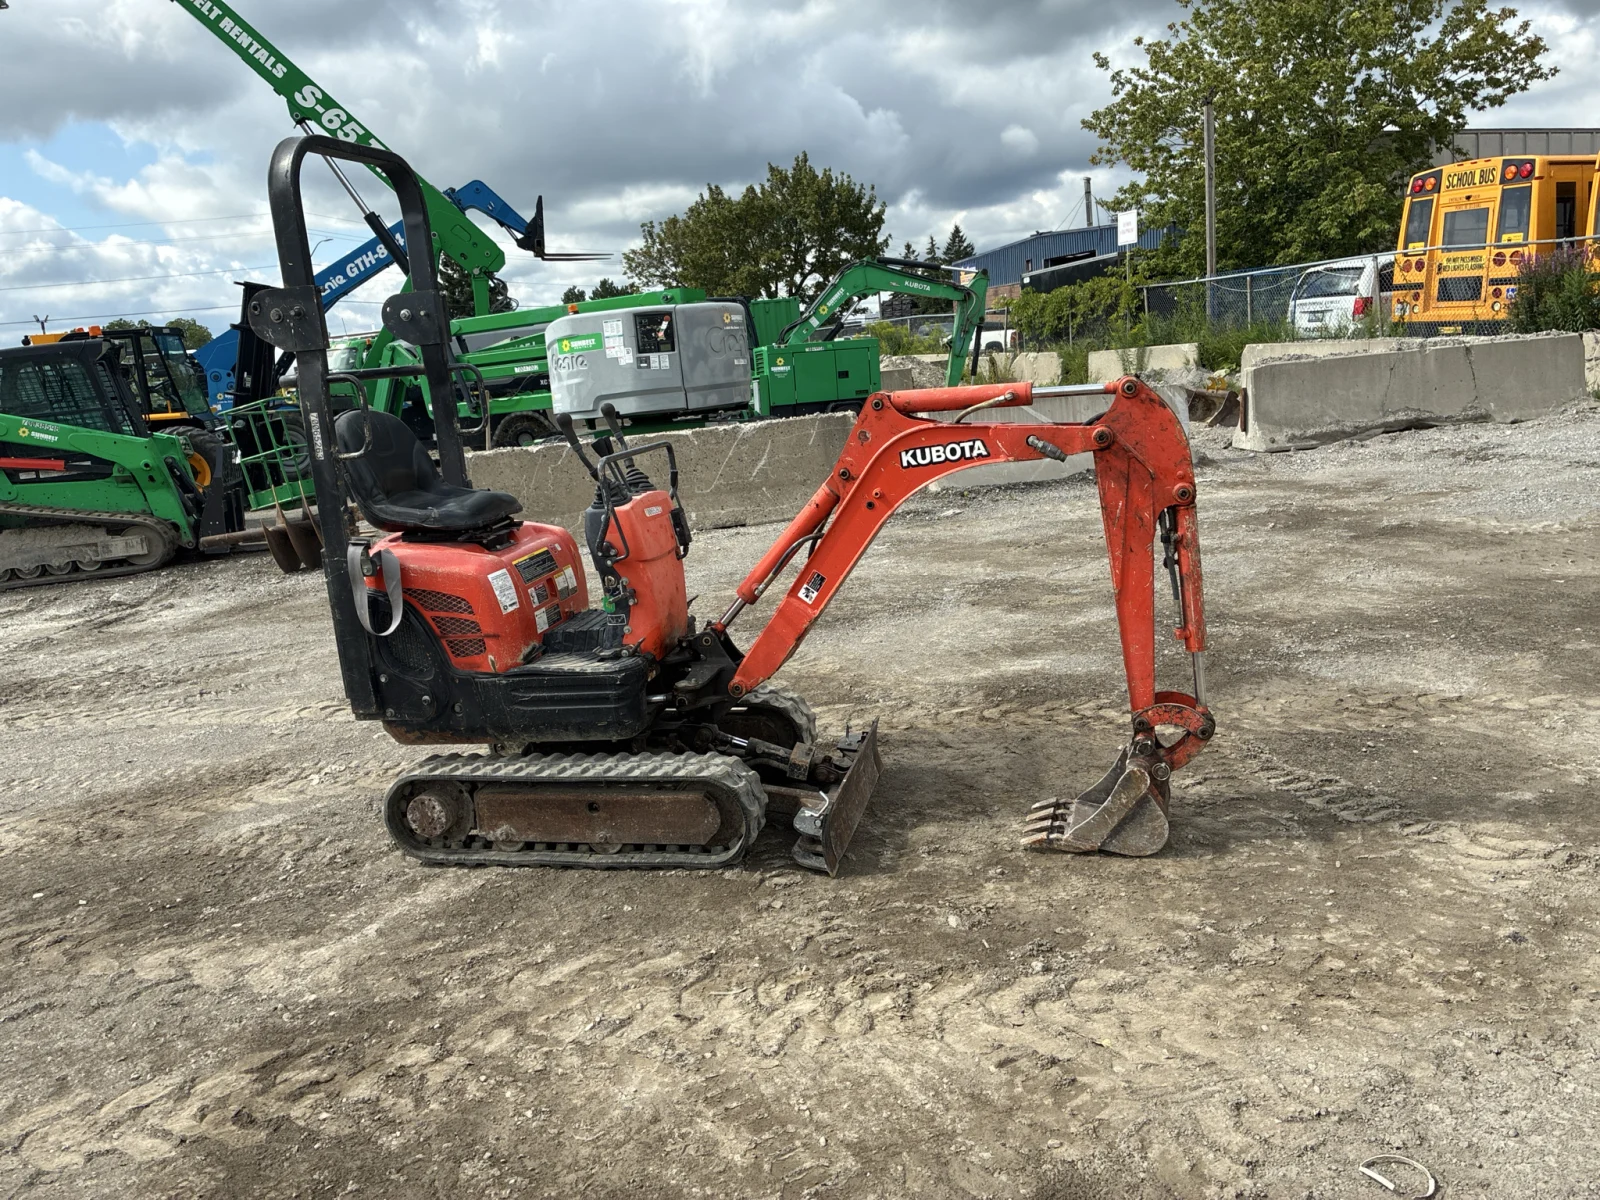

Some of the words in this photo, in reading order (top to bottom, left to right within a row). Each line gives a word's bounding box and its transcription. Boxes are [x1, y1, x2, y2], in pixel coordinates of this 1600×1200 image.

[189, 0, 222, 20] ELT
[219, 16, 287, 78] RENTALS
[294, 85, 365, 143] S-65
[1446, 171, 1476, 189] SCHOOL
[1479, 168, 1496, 184] BUS
[346, 233, 404, 278] GTH-84
[904, 280, 931, 292] KUBOTA
[570, 338, 596, 348] SUNBELT
[31, 431, 58, 441] SUNBELT
[900, 439, 988, 468] KUBOTA
